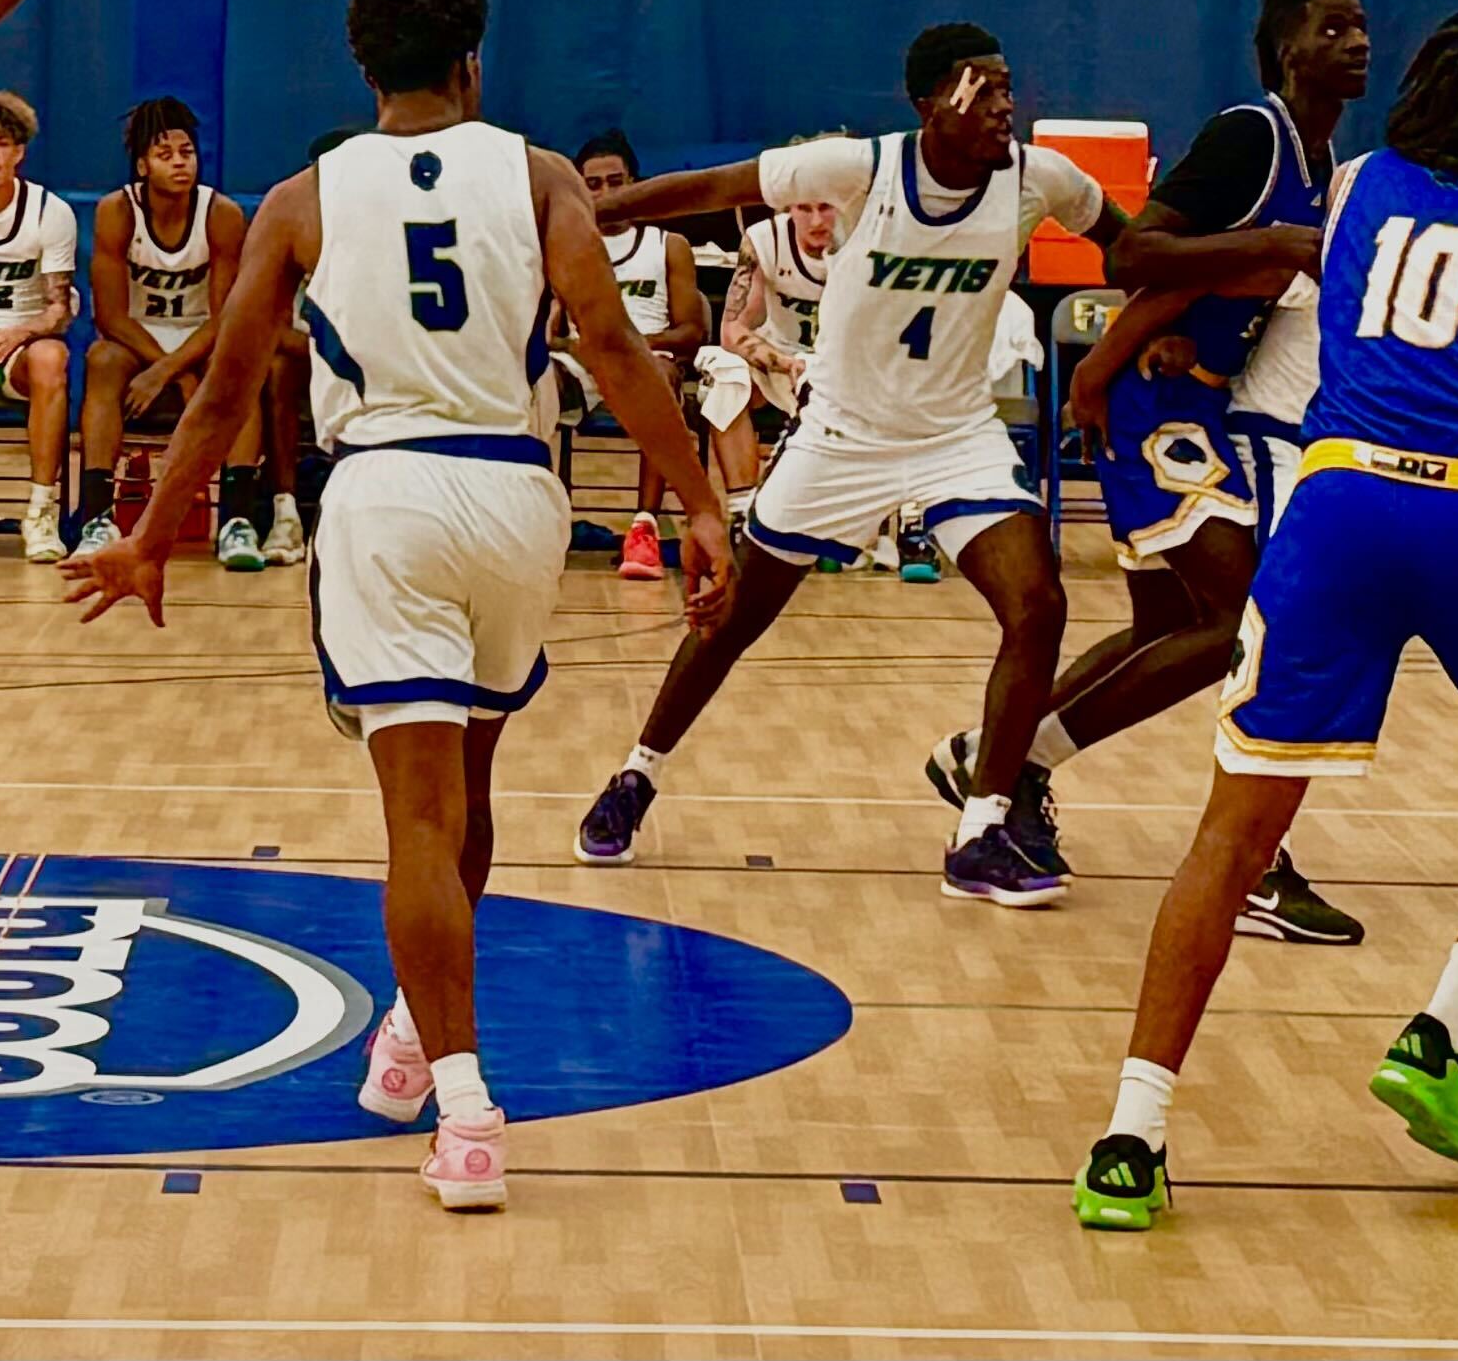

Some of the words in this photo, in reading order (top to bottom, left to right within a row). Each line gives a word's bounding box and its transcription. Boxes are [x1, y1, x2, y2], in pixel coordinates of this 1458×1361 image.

[403, 217, 469, 332] 5
[867, 250, 998, 293] YETIS
[145, 293, 184, 317] 21
[899, 306, 936, 360] 4
